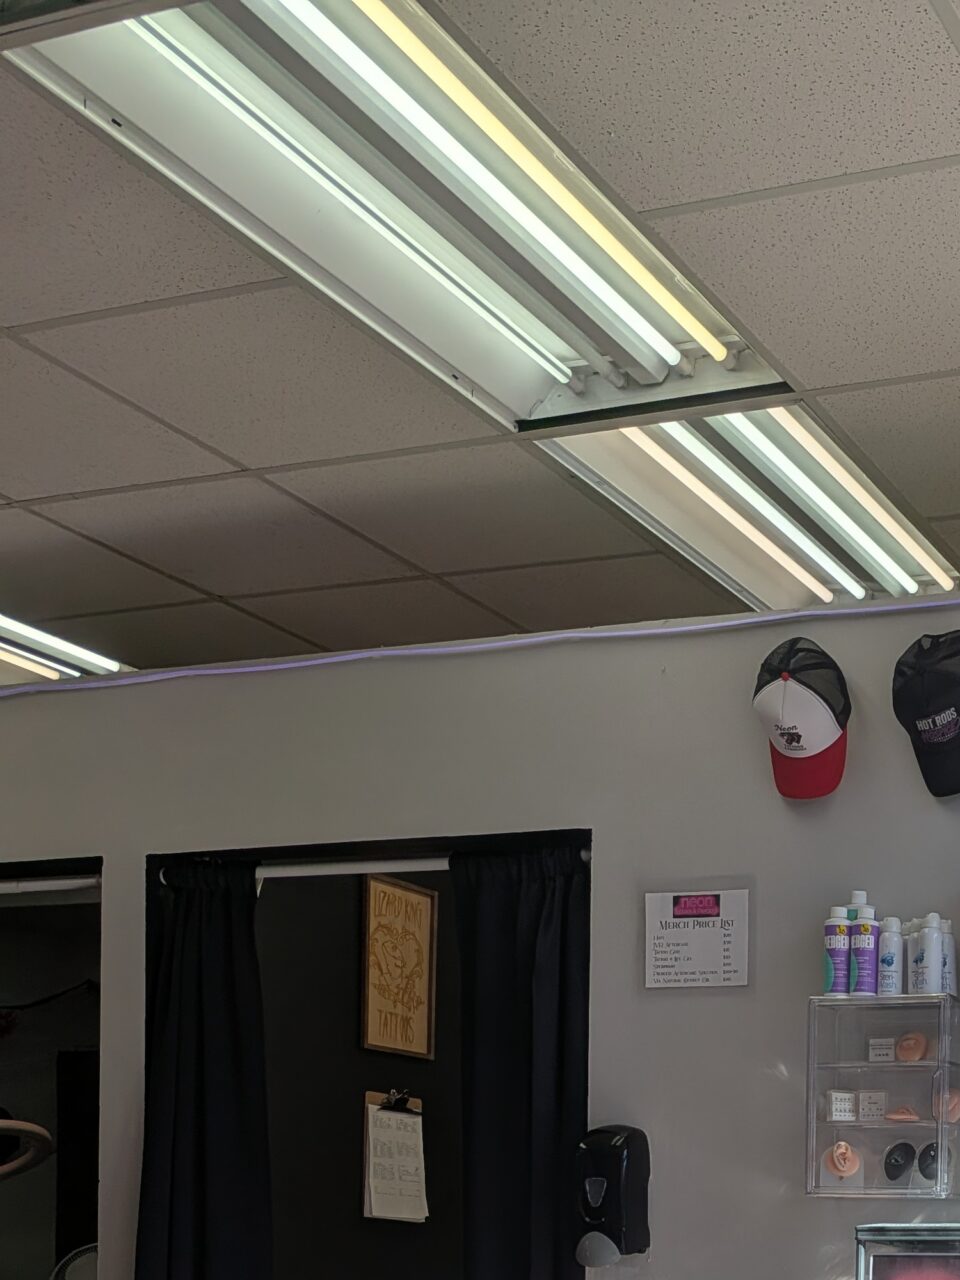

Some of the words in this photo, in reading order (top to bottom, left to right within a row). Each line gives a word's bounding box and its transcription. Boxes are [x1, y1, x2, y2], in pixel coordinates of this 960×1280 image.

[774, 723, 798, 732] Neon
[915, 718, 934, 731] HOT
[935, 707, 957, 727] RODS
[374, 888, 403, 918] LIZARD
[404, 899, 422, 929] KING
[659, 920, 690, 931] MERCH
[692, 919, 717, 930] PRICE
[720, 919, 735, 931] LIST
[377, 1008, 415, 1044] TATTOOS
